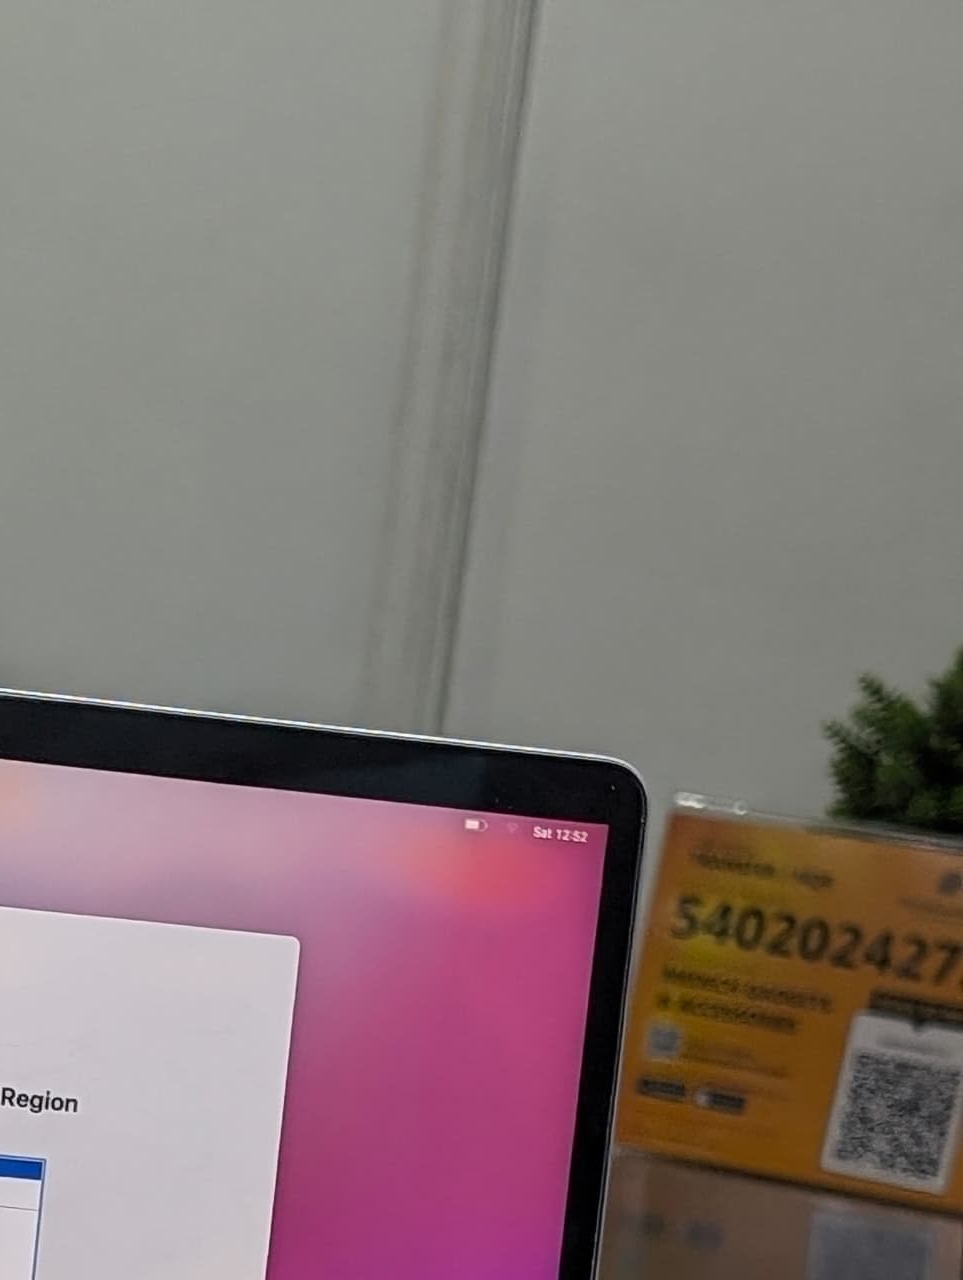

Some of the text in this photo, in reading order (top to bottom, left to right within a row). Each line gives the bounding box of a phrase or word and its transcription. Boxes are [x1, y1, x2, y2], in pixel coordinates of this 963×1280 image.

[533, 826, 588, 843] Sat 12:52
[670, 894, 963, 985] 540202427
[1, 1087, 79, 1113] Region
